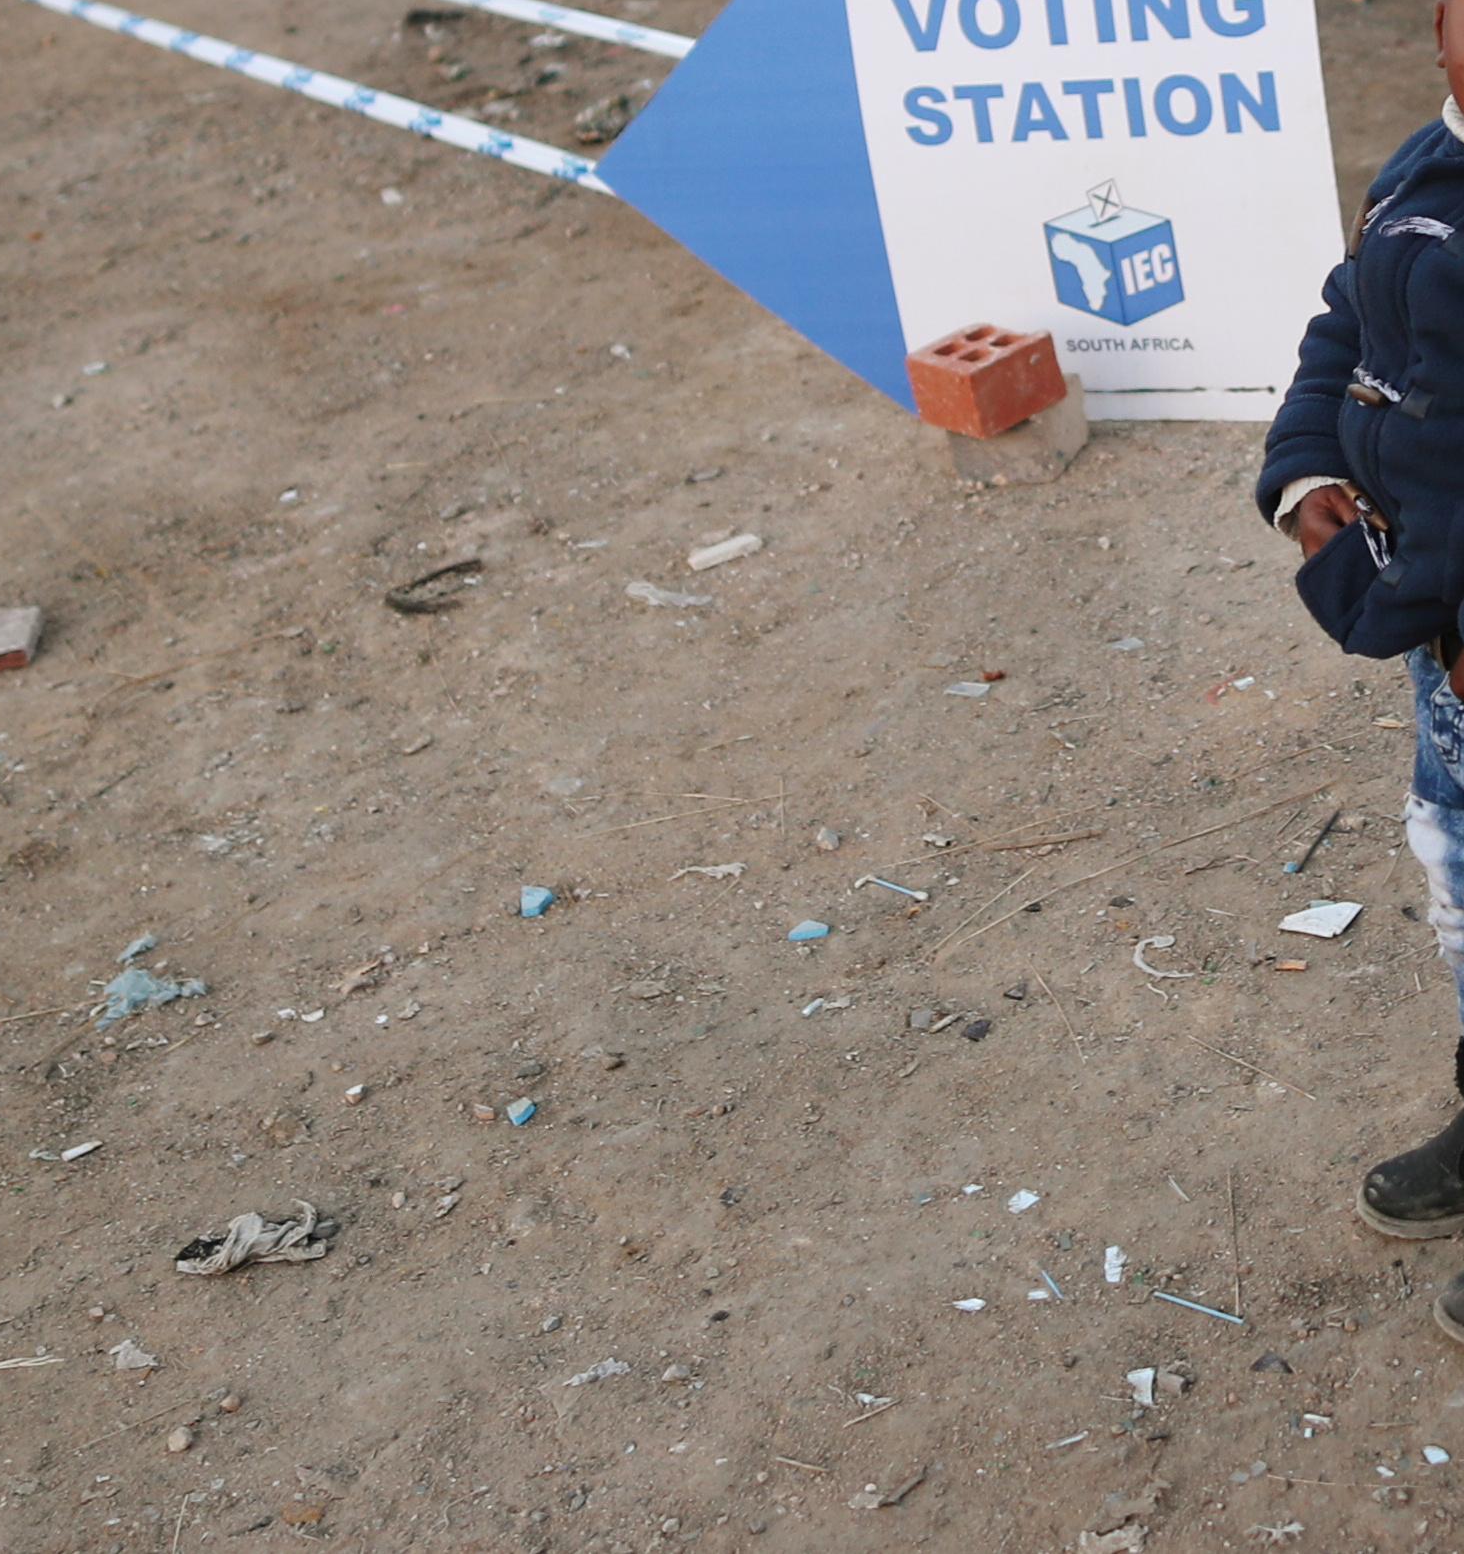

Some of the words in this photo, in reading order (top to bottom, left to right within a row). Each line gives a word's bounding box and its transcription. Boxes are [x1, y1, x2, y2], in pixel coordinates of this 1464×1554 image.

[902, 70, 1282, 147] STATION
[1120, 243, 1175, 296] IEC
[1065, 337, 1126, 353] SOUTH
[1130, 337, 1195, 352] AFRICA
